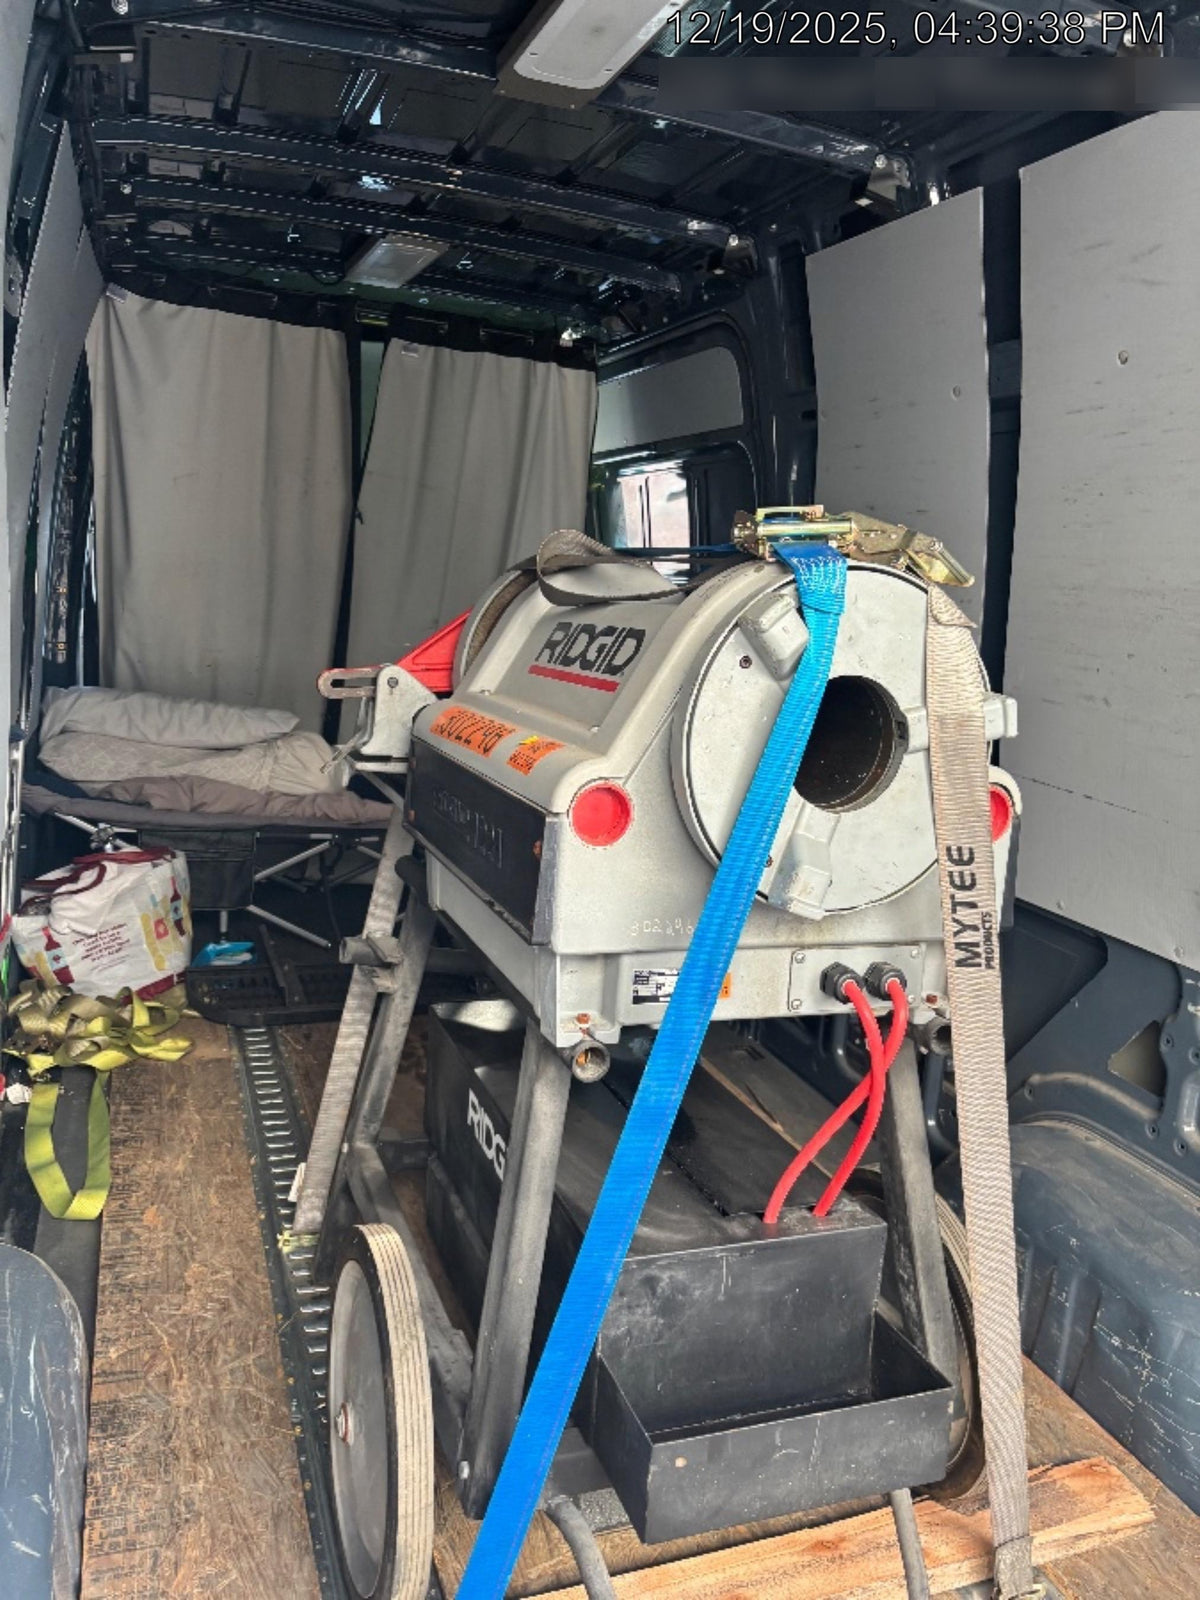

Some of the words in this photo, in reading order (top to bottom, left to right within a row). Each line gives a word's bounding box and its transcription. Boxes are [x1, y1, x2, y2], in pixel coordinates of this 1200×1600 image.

[535, 622, 646, 676] RIDGID
[946, 846, 982, 967] MYTEE
[981, 912, 996, 970] PRODUCTS
[467, 1088, 506, 1181] RIDG
